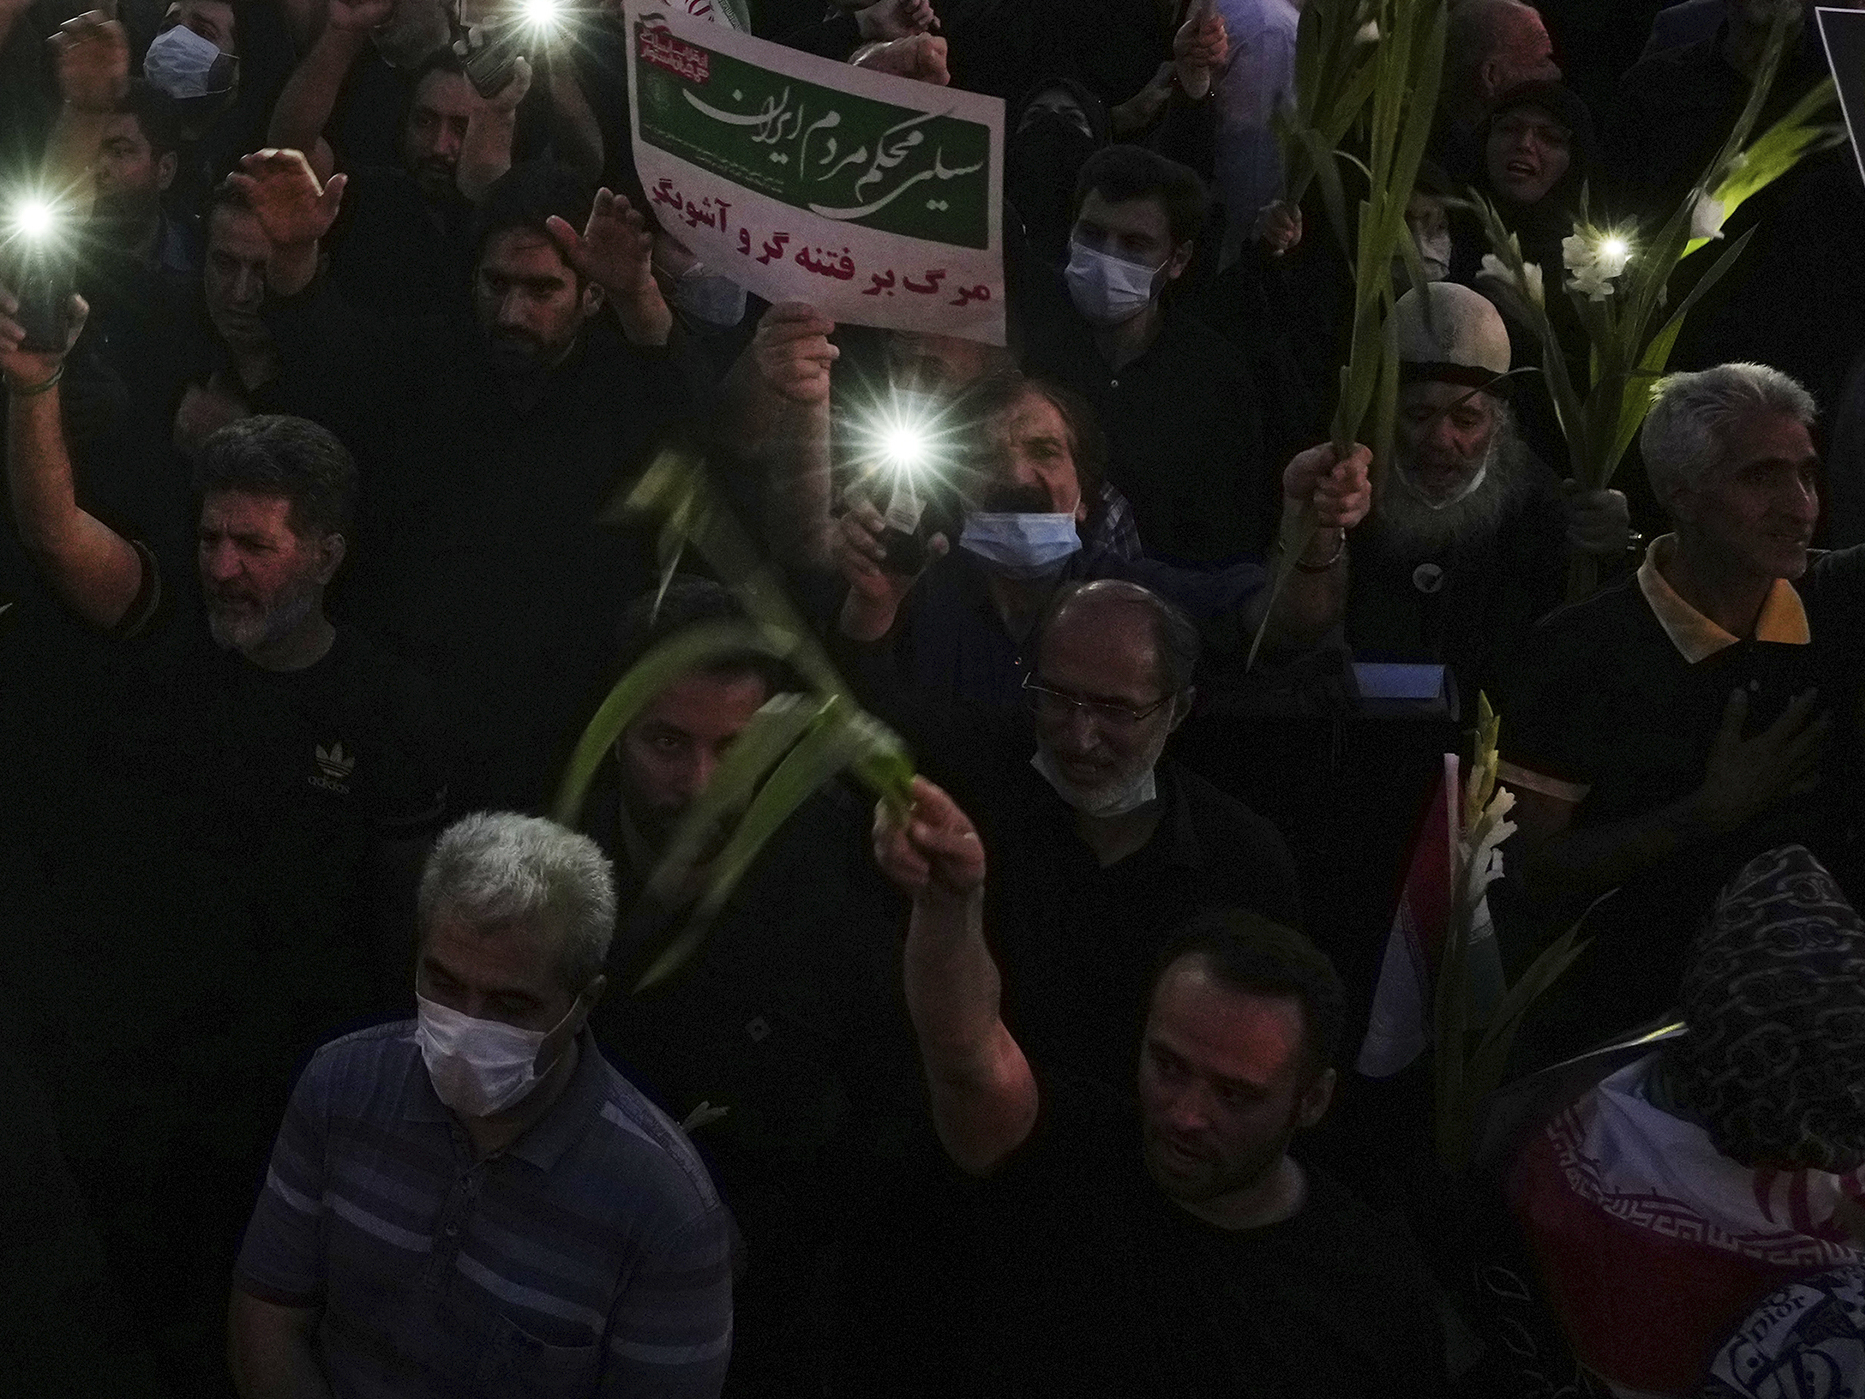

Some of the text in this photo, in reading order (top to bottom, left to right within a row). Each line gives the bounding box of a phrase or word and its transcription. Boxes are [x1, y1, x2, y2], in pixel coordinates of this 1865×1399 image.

[682, 86, 803, 165] ایران
[800, 110, 868, 181] مردم
[854, 107, 955, 203] محکم
[809, 145, 985, 221] سیلی
[736, 227, 751, 256] و
[794, 247, 855, 281] فتنه
[862, 269, 896, 296] بر
[903, 268, 991, 307] مرگ
[308, 775, 350, 796] adidas
[1751, 1295, 1804, 1342] Dior
